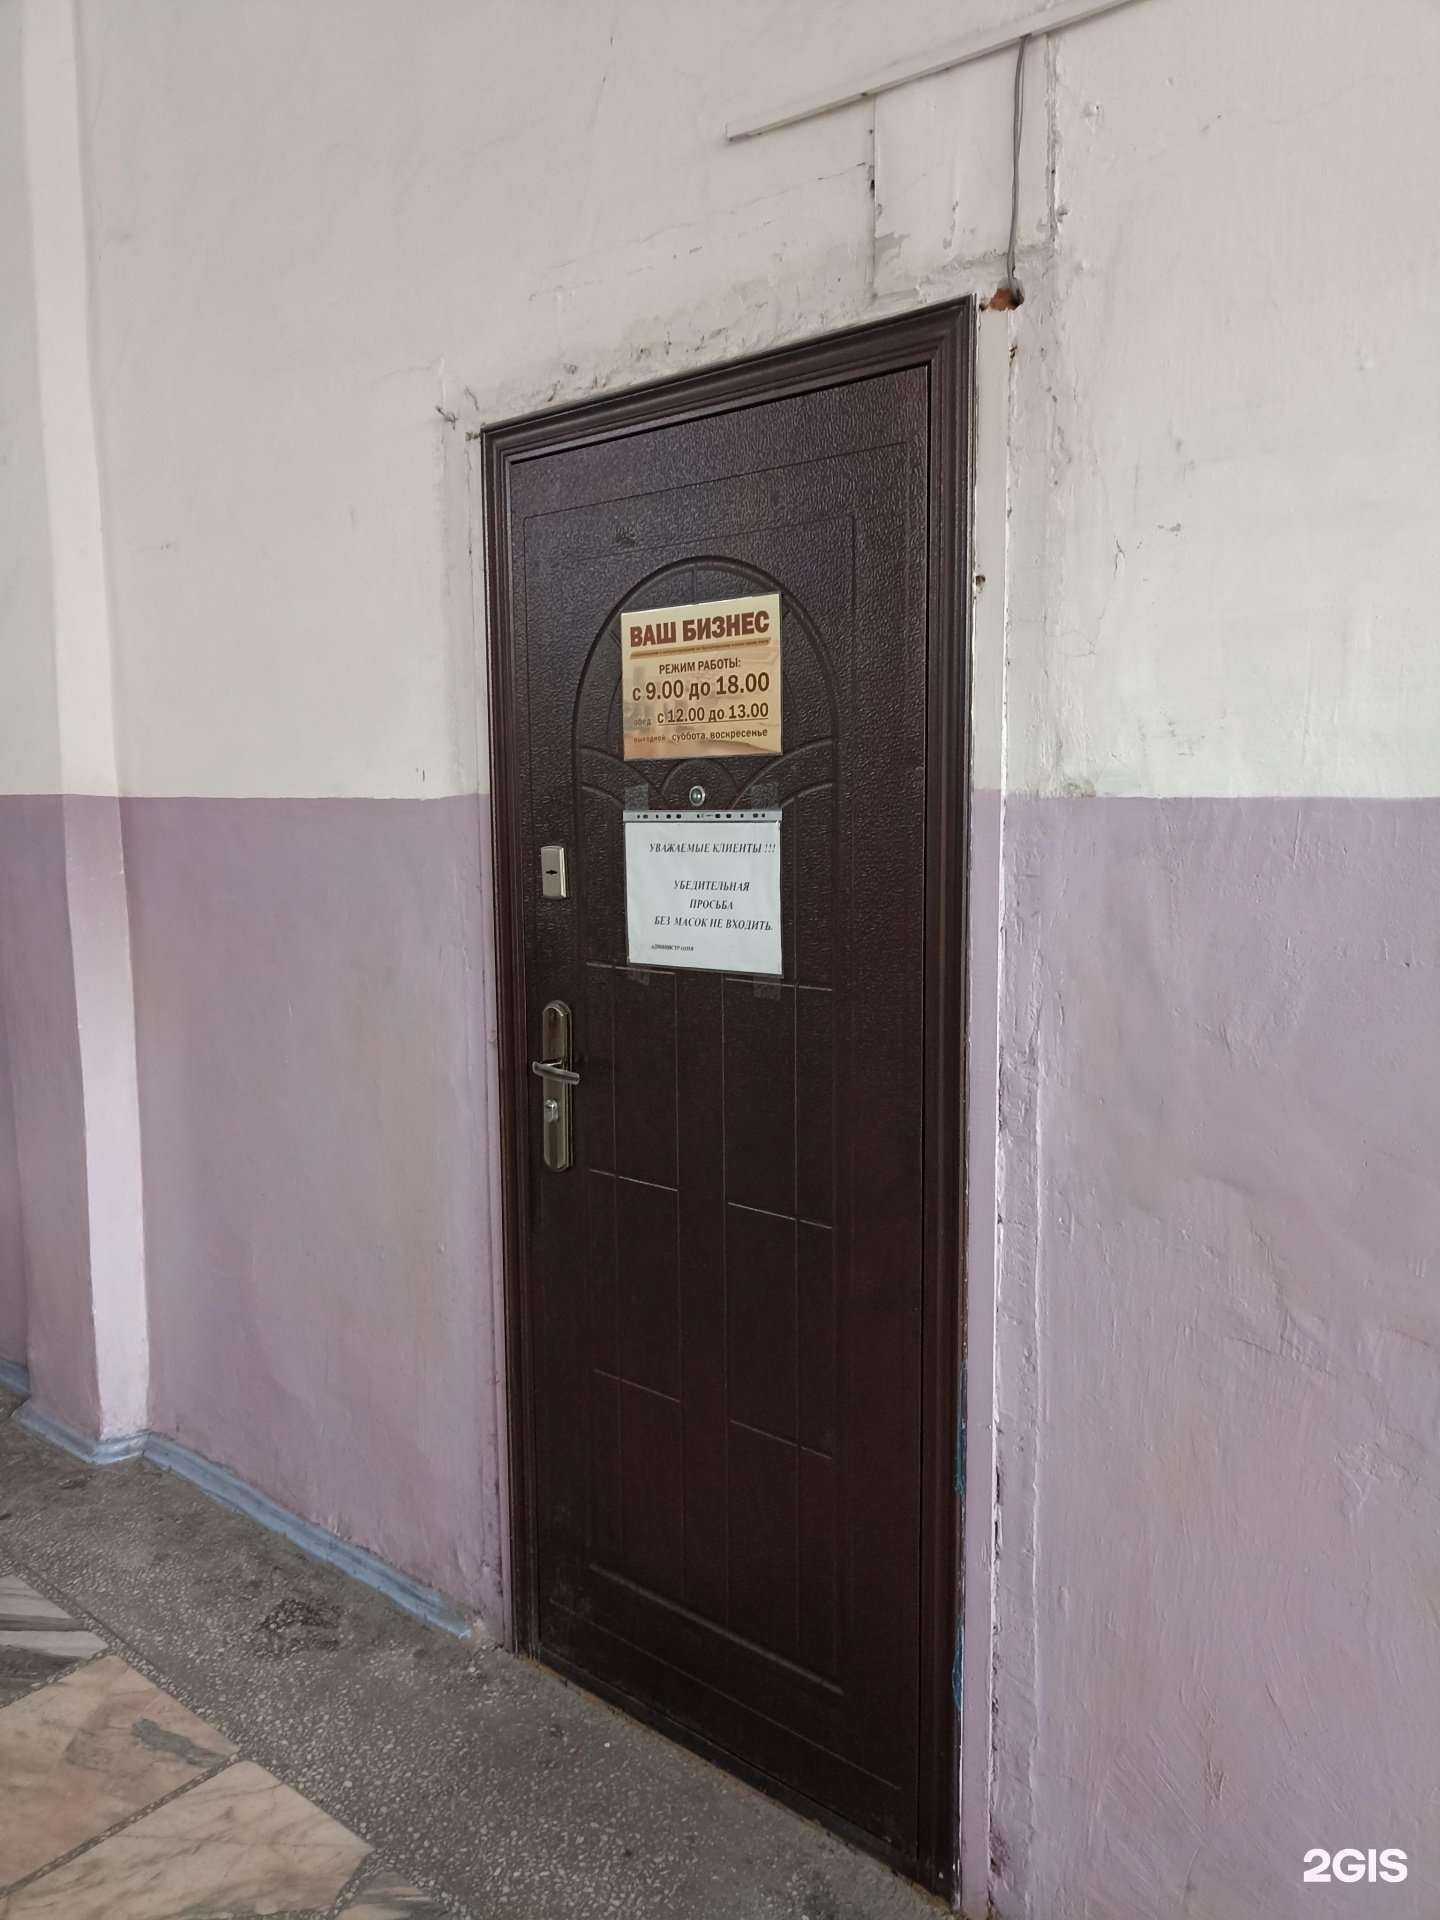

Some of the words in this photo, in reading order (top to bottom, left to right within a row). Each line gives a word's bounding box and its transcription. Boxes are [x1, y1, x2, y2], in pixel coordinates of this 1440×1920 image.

[630, 622, 676, 647] ВАШ
[683, 611, 769, 641] БИЗНЕС
[659, 661, 695, 675] РЕЖИМ
[698, 657, 741, 670] РАБОТЫ:
[645, 679, 684, 700] 9.00
[688, 681, 710, 700] до
[716, 672, 769, 695] 18.00
[668, 707, 705, 722] 12.00
[709, 709, 724, 722] до
[729, 703, 768, 719] 13.00
[710, 728, 768, 739] воскресенье
[649, 843, 710, 853] УВАЖАЕМЫЕ
[713, 843, 762, 853] КЛИЕНТЫ
[674, 880, 750, 891] УБЕДИТЕЛЬНАЯ
[689, 899, 733, 910] ПРОСЬБА
[655, 916, 670, 925] БЕЗ
[674, 917, 708, 927] МАСОК
[710, 919, 723, 928] НЕ
[726, 920, 773, 931] ВХОДИТЬ.
